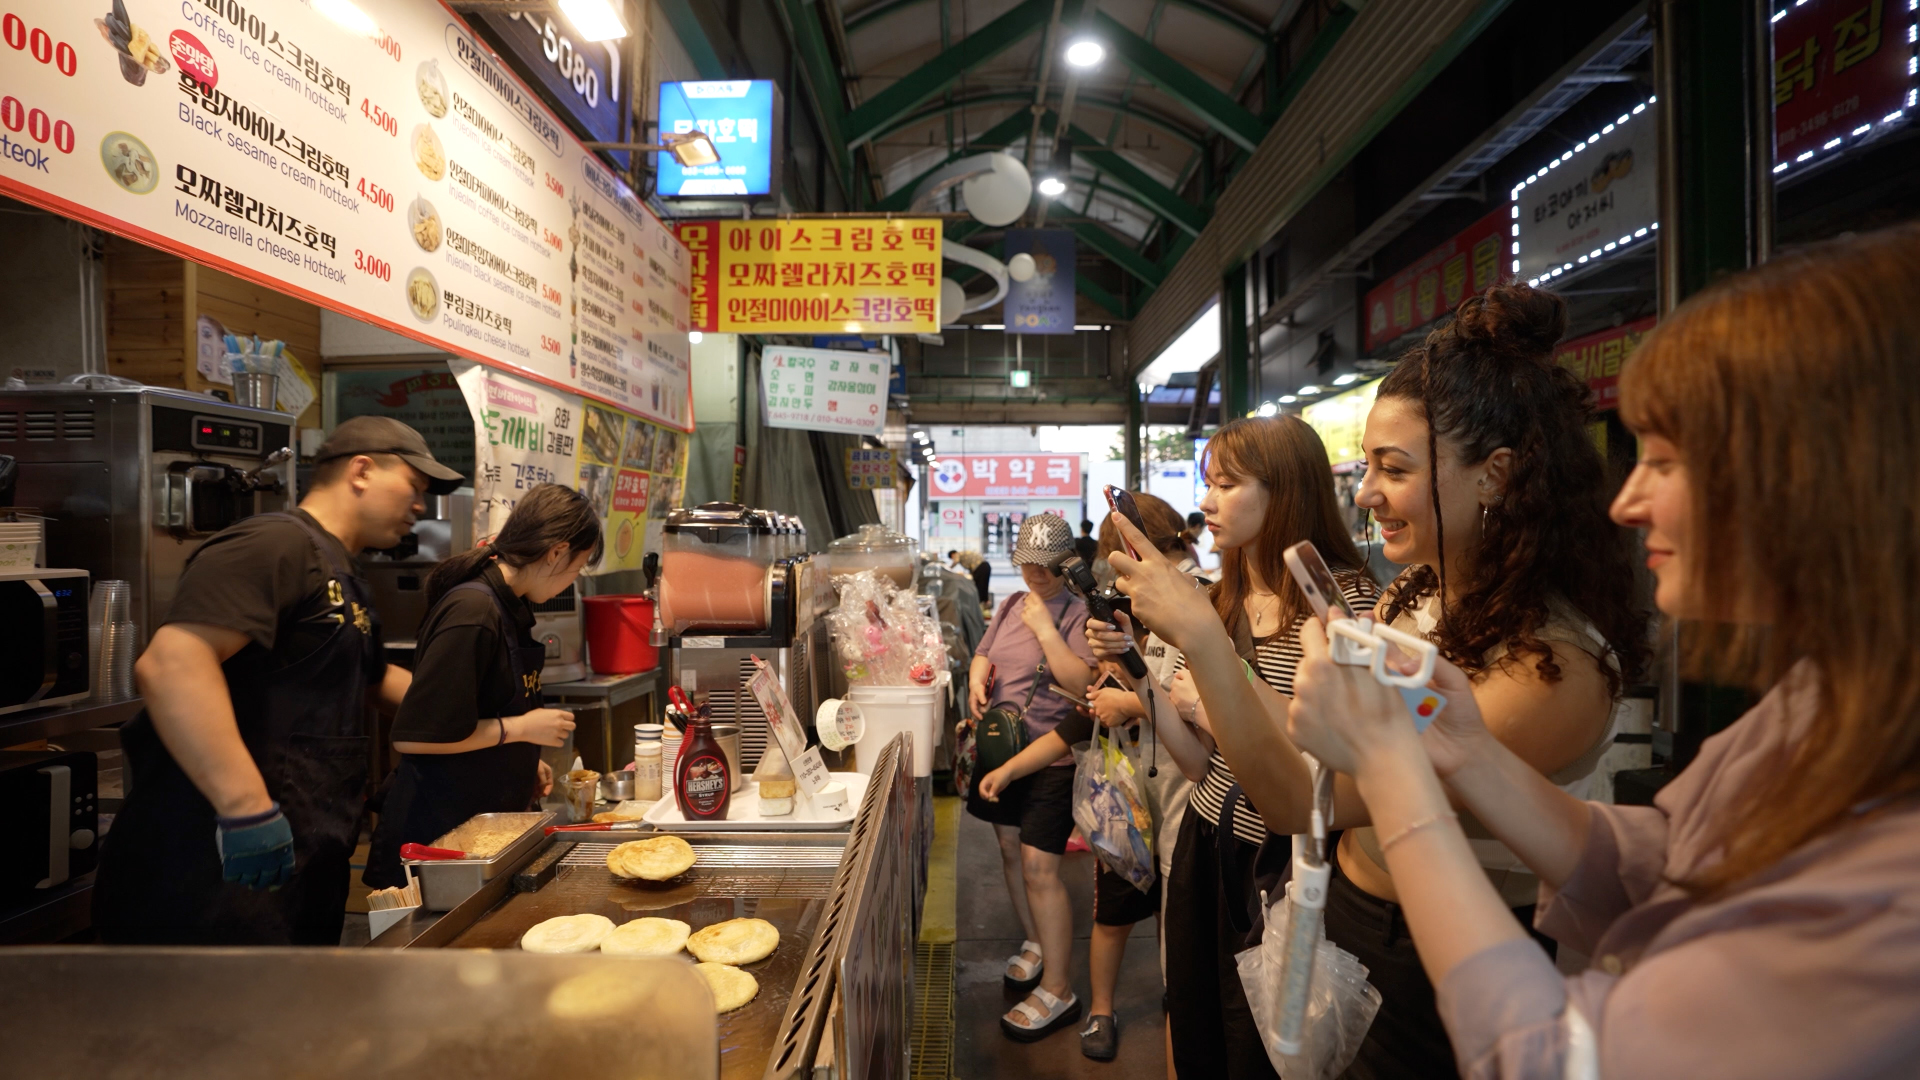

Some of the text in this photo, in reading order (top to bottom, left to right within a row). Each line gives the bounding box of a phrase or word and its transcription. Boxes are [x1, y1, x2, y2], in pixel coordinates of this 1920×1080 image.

[182, 1, 347, 124] Coffee Ice cream hotteok
[197, 0, 351, 106] 피아이스크림호떡
[457, 36, 560, 150] 인절미아이스크림호떡
[178, 69, 350, 189] 흑임자아이스크림호떡
[361, 97, 398, 137] 4,500
[453, 92, 535, 175] 인절미아이스크림호떡
[178, 102, 360, 214] Black sesame cream hotteok
[174, 164, 336, 259] 모짜렐라치즈호떡
[356, 177, 394, 213] 4,500
[449, 160, 538, 235] 인절미커피아이스크림호떡
[175, 199, 347, 285] Mozzarella cheese Hotteok
[582, 234, 625, 274] 커피아이스크림
[729, 226, 936, 252] 아이스크림호떡
[354, 249, 391, 282] 3,000
[447, 228, 538, 292] 인절미흑임자아이스크림호떡
[473, 264, 492, 286] Black
[728, 262, 936, 288] 모짜렐라치즈호떡
[444, 290, 512, 335] 뿌링클치즈호떡
[727, 297, 935, 323] 인절미아이스크림호떡
[483, 331, 506, 349] cheese
[616, 474, 649, 496] 모자호떡
[972, 458, 1072, 484] 박약국
[943, 508, 964, 529] 약
[688, 778, 723, 792] HERSHEY'S
